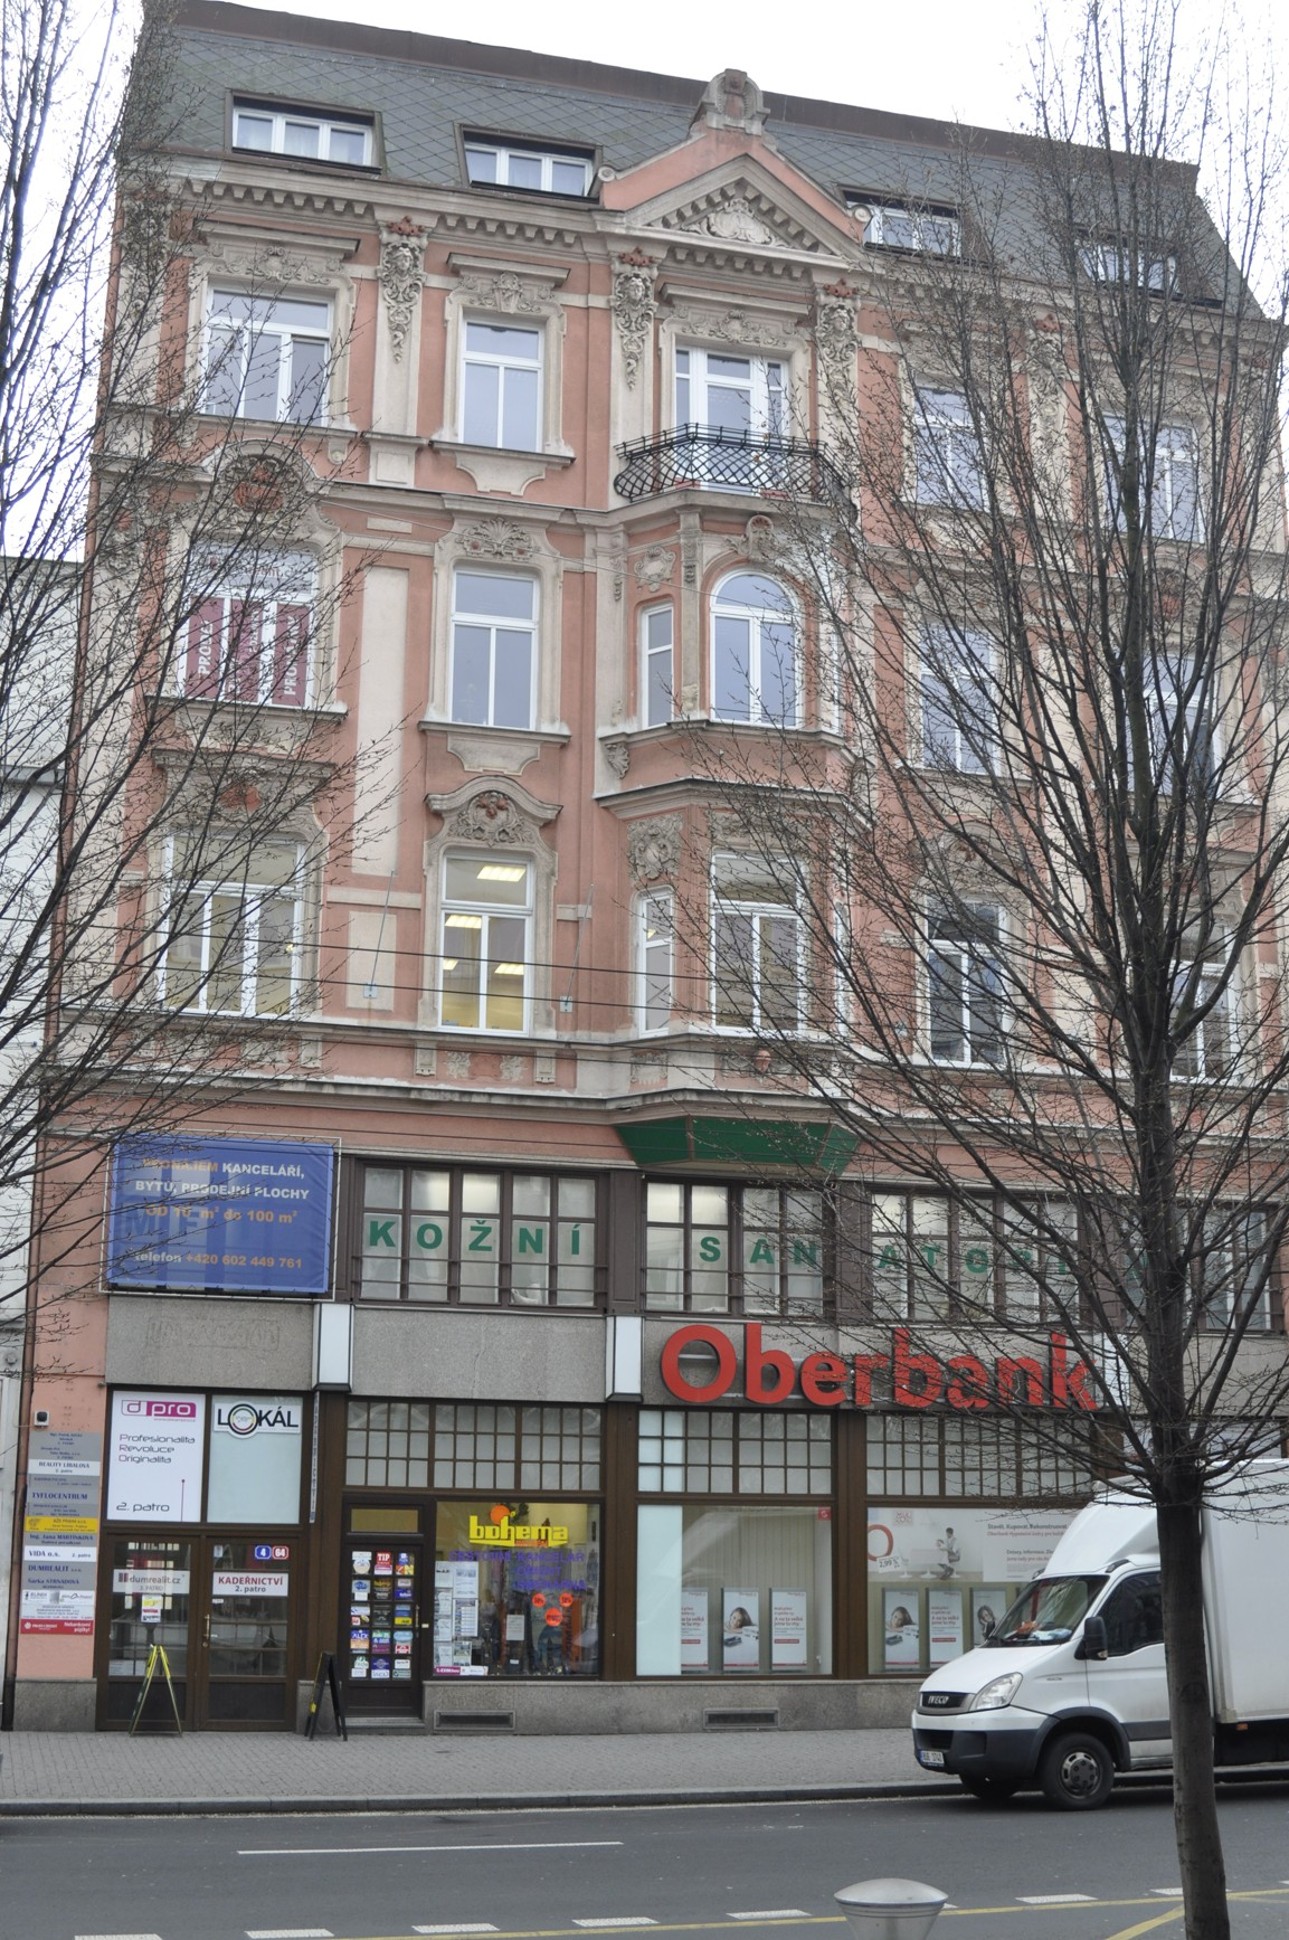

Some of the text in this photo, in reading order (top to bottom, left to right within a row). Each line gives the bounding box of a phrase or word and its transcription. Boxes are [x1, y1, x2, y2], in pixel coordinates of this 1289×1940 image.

[254, 1187, 309, 1200] PLOCHY
[247, 1210, 274, 1223] 100
[369, 1220, 581, 1255] KOŽNÍ
[135, 1251, 182, 1263] telefon
[222, 1255, 246, 1266] 602
[250, 1256, 274, 1267] 449
[279, 1257, 302, 1268] 761
[661, 1322, 1099, 1410] Oberbank
[217, 1403, 299, 1435] LOKÁL
[119, 1444, 175, 1453] Revoluce
[118, 1454, 172, 1464] Originalita
[133, 1503, 170, 1512] patro
[129, 1575, 181, 1585] dumrealit.cz
[218, 1575, 283, 1586] KADEŘNICTVÍ
[928, 1695, 949, 1704] IVECO
